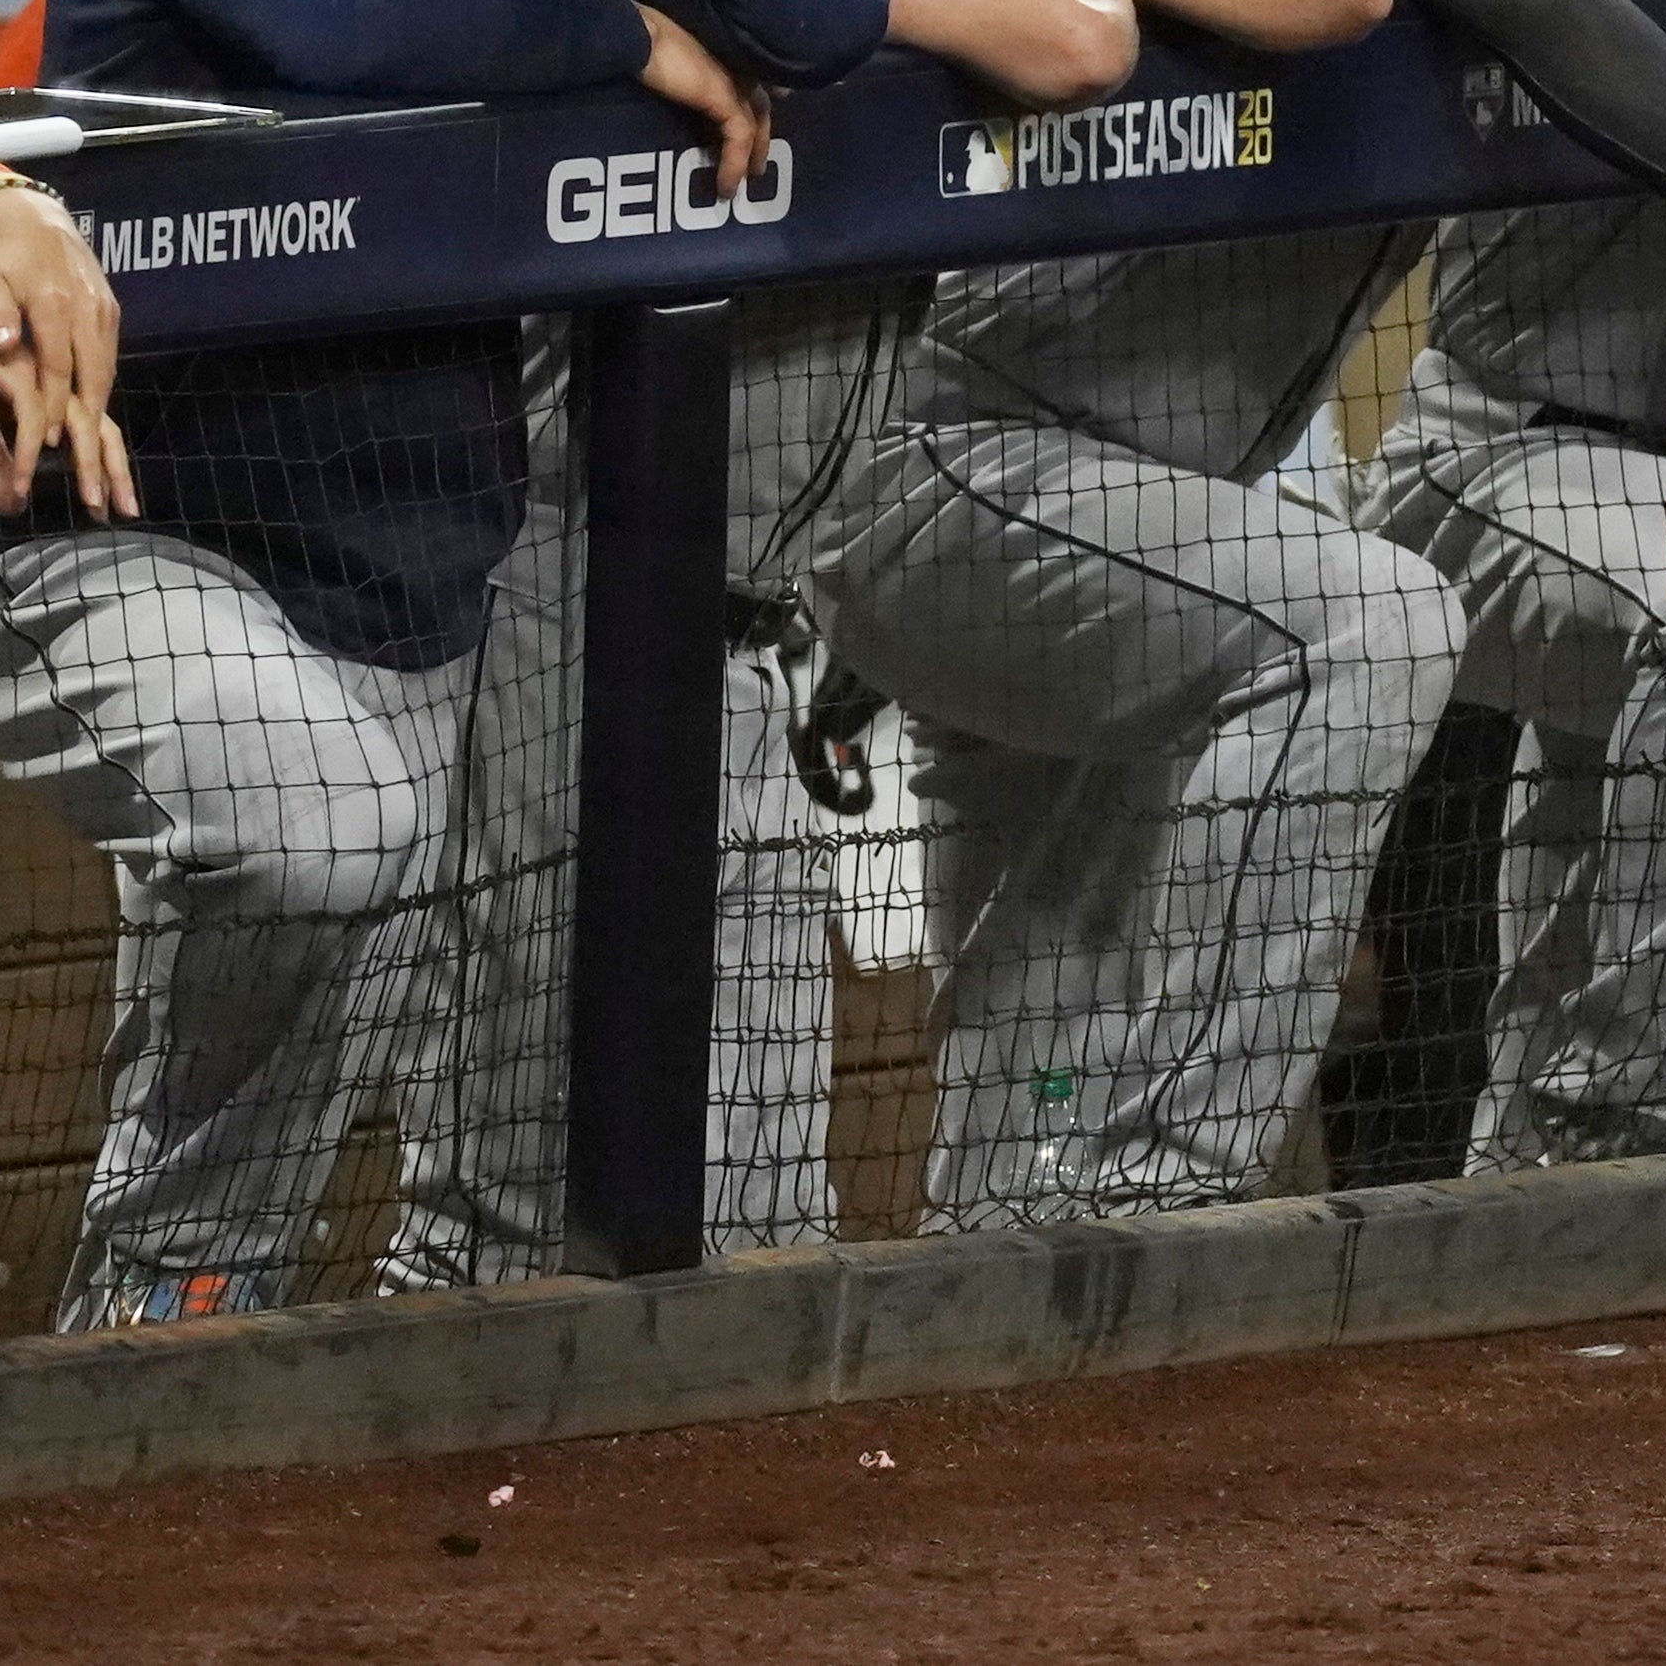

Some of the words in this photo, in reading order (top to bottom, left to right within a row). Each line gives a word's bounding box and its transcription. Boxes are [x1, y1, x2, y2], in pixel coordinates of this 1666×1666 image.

[1018, 92, 1235, 190] POSTSEASON
[1238, 88, 1273, 127] 20
[1238, 126, 1272, 166] 20
[547, 138, 793, 243] GEICO
[102, 216, 174, 274] MLB
[181, 196, 356, 266] NETWORK
